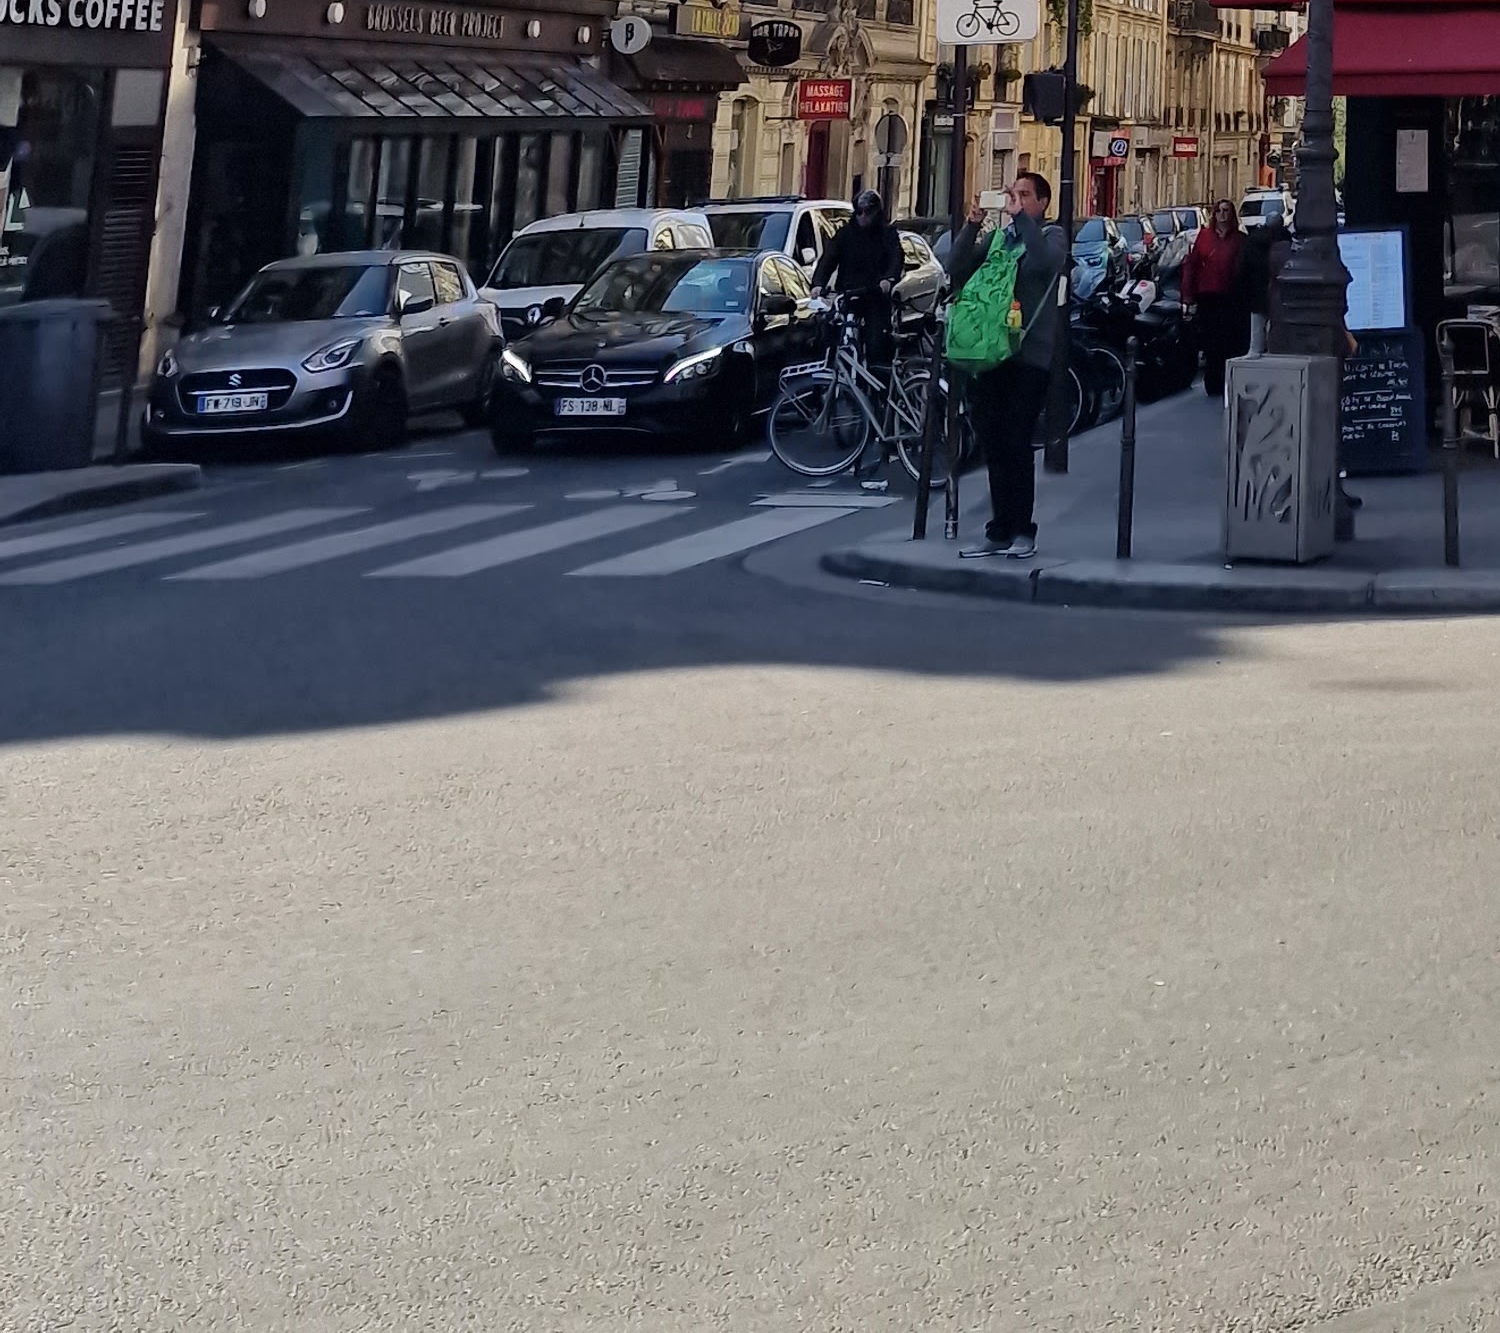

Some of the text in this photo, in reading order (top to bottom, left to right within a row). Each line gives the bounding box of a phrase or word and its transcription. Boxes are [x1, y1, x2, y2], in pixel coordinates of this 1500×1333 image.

[367, 4, 505, 38] BRUSSELS BEER PROJECT
[806, 84, 845, 97] MASSAGE
[800, 101, 849, 113] RELAXATION
